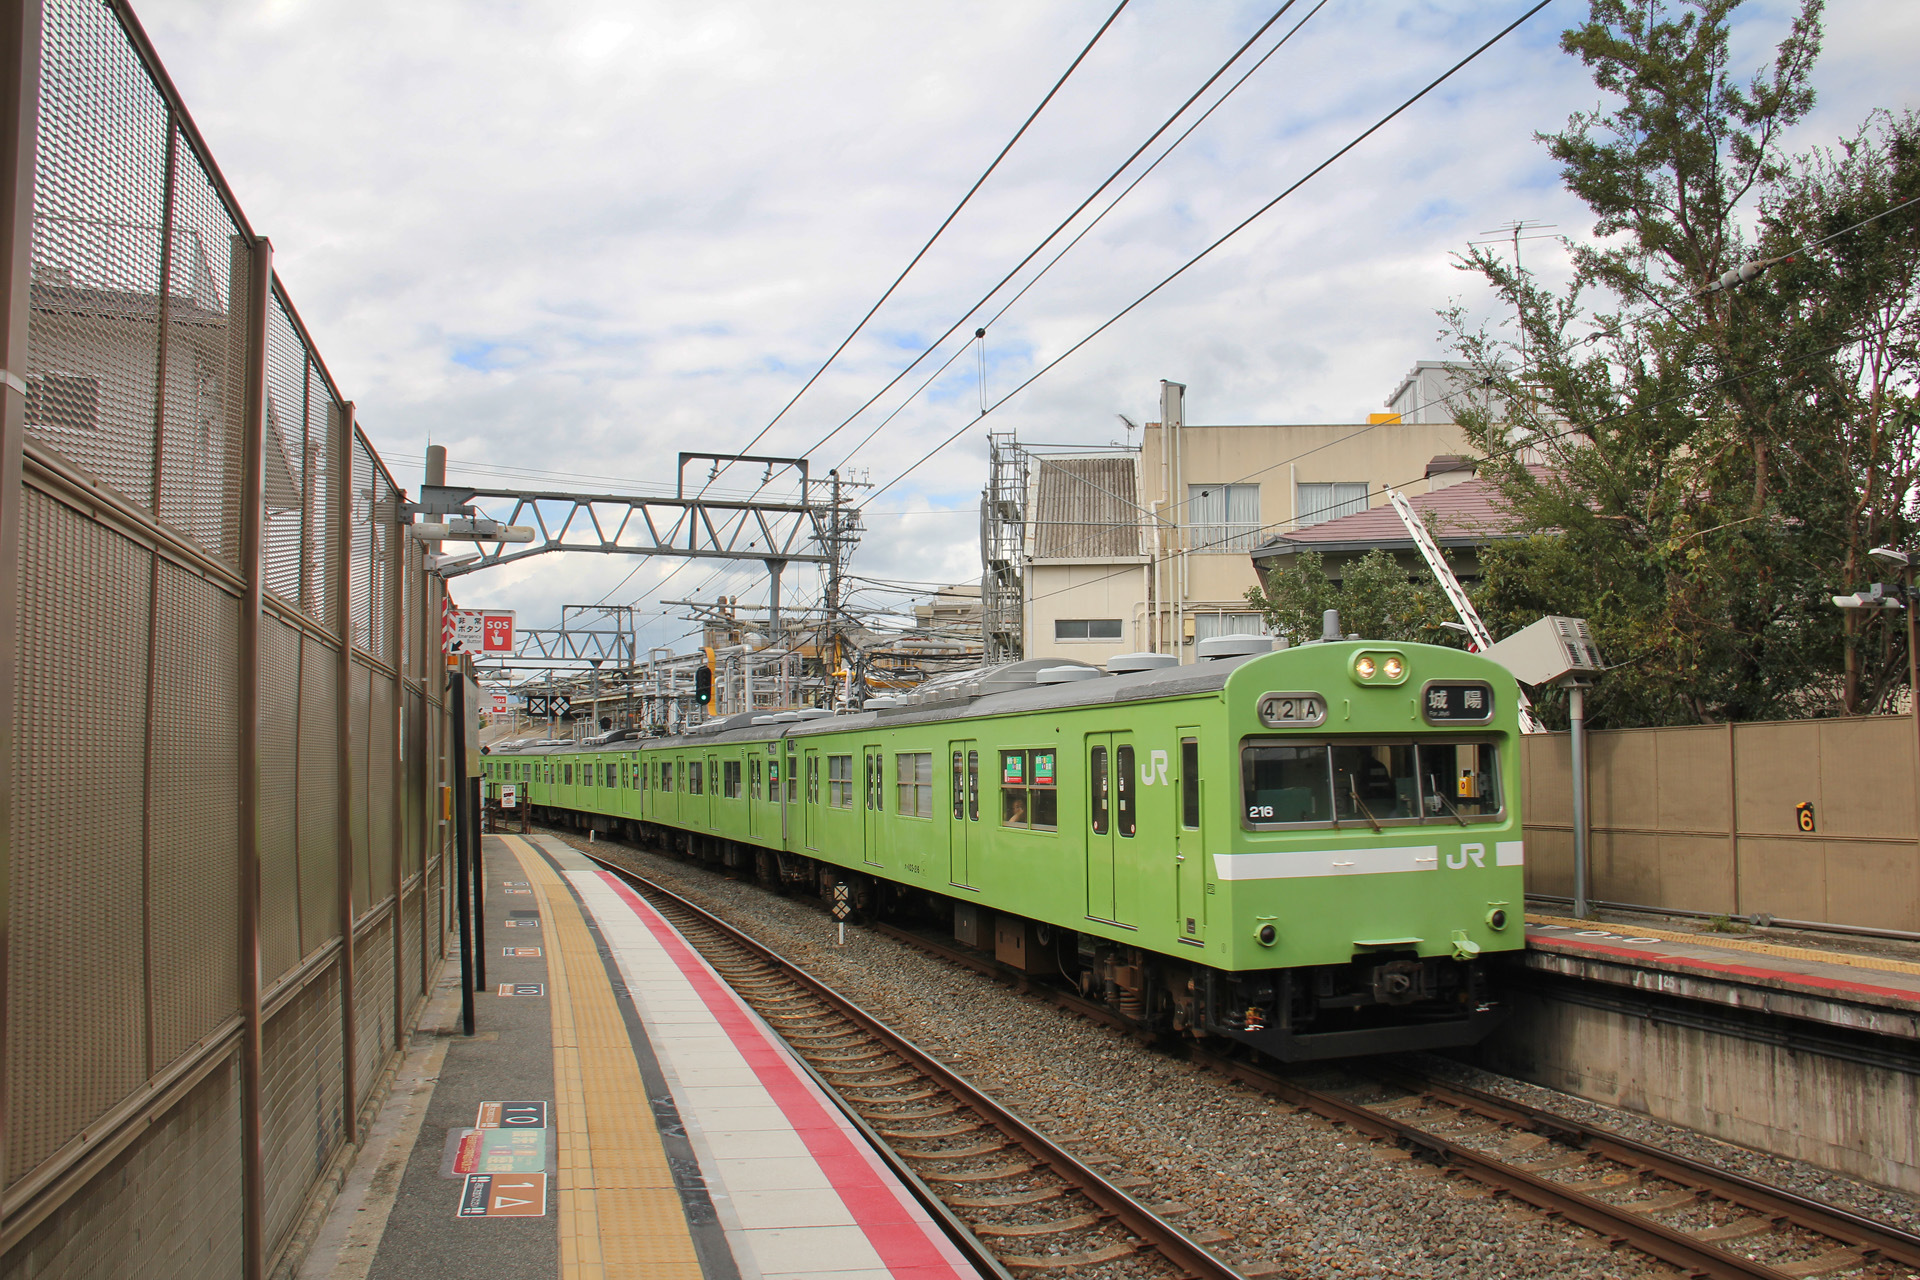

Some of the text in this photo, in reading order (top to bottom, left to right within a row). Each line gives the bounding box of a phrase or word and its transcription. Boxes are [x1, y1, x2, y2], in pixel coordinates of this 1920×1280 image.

[458, 625, 482, 633] ボタン
[487, 620, 510, 630] SOS
[1428, 690, 1483, 709] 城陽
[1141, 750, 1169, 786] JR
[1249, 806, 1273, 818] 216
[1800, 809, 1813, 831] 6
[1446, 843, 1486, 869] JR
